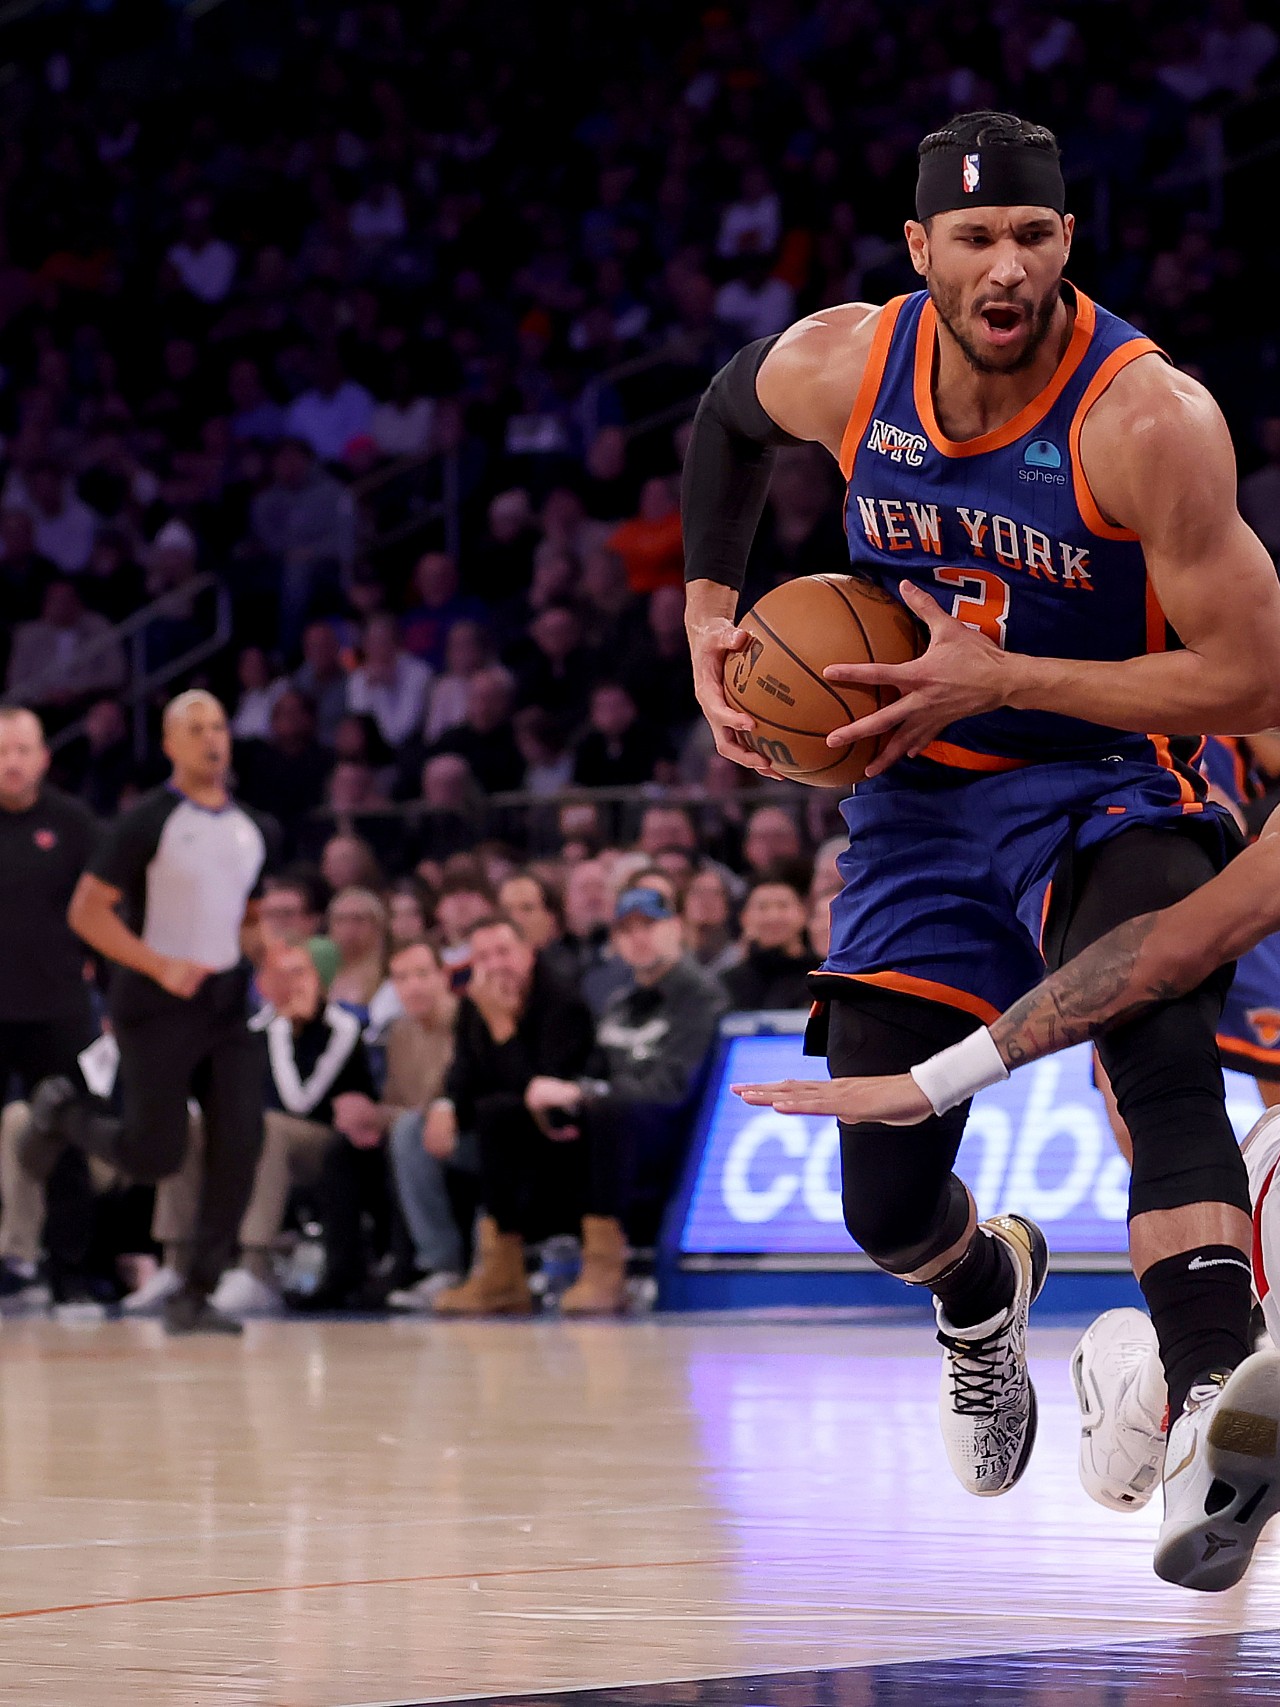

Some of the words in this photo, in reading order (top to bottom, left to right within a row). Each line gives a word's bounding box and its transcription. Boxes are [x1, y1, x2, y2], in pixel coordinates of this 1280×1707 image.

[867, 419, 928, 467] NYC
[1018, 468, 1066, 486] sphere
[856, 495, 942, 556] NEW
[956, 506, 1095, 592] YORK
[933, 566, 1010, 652] 3
